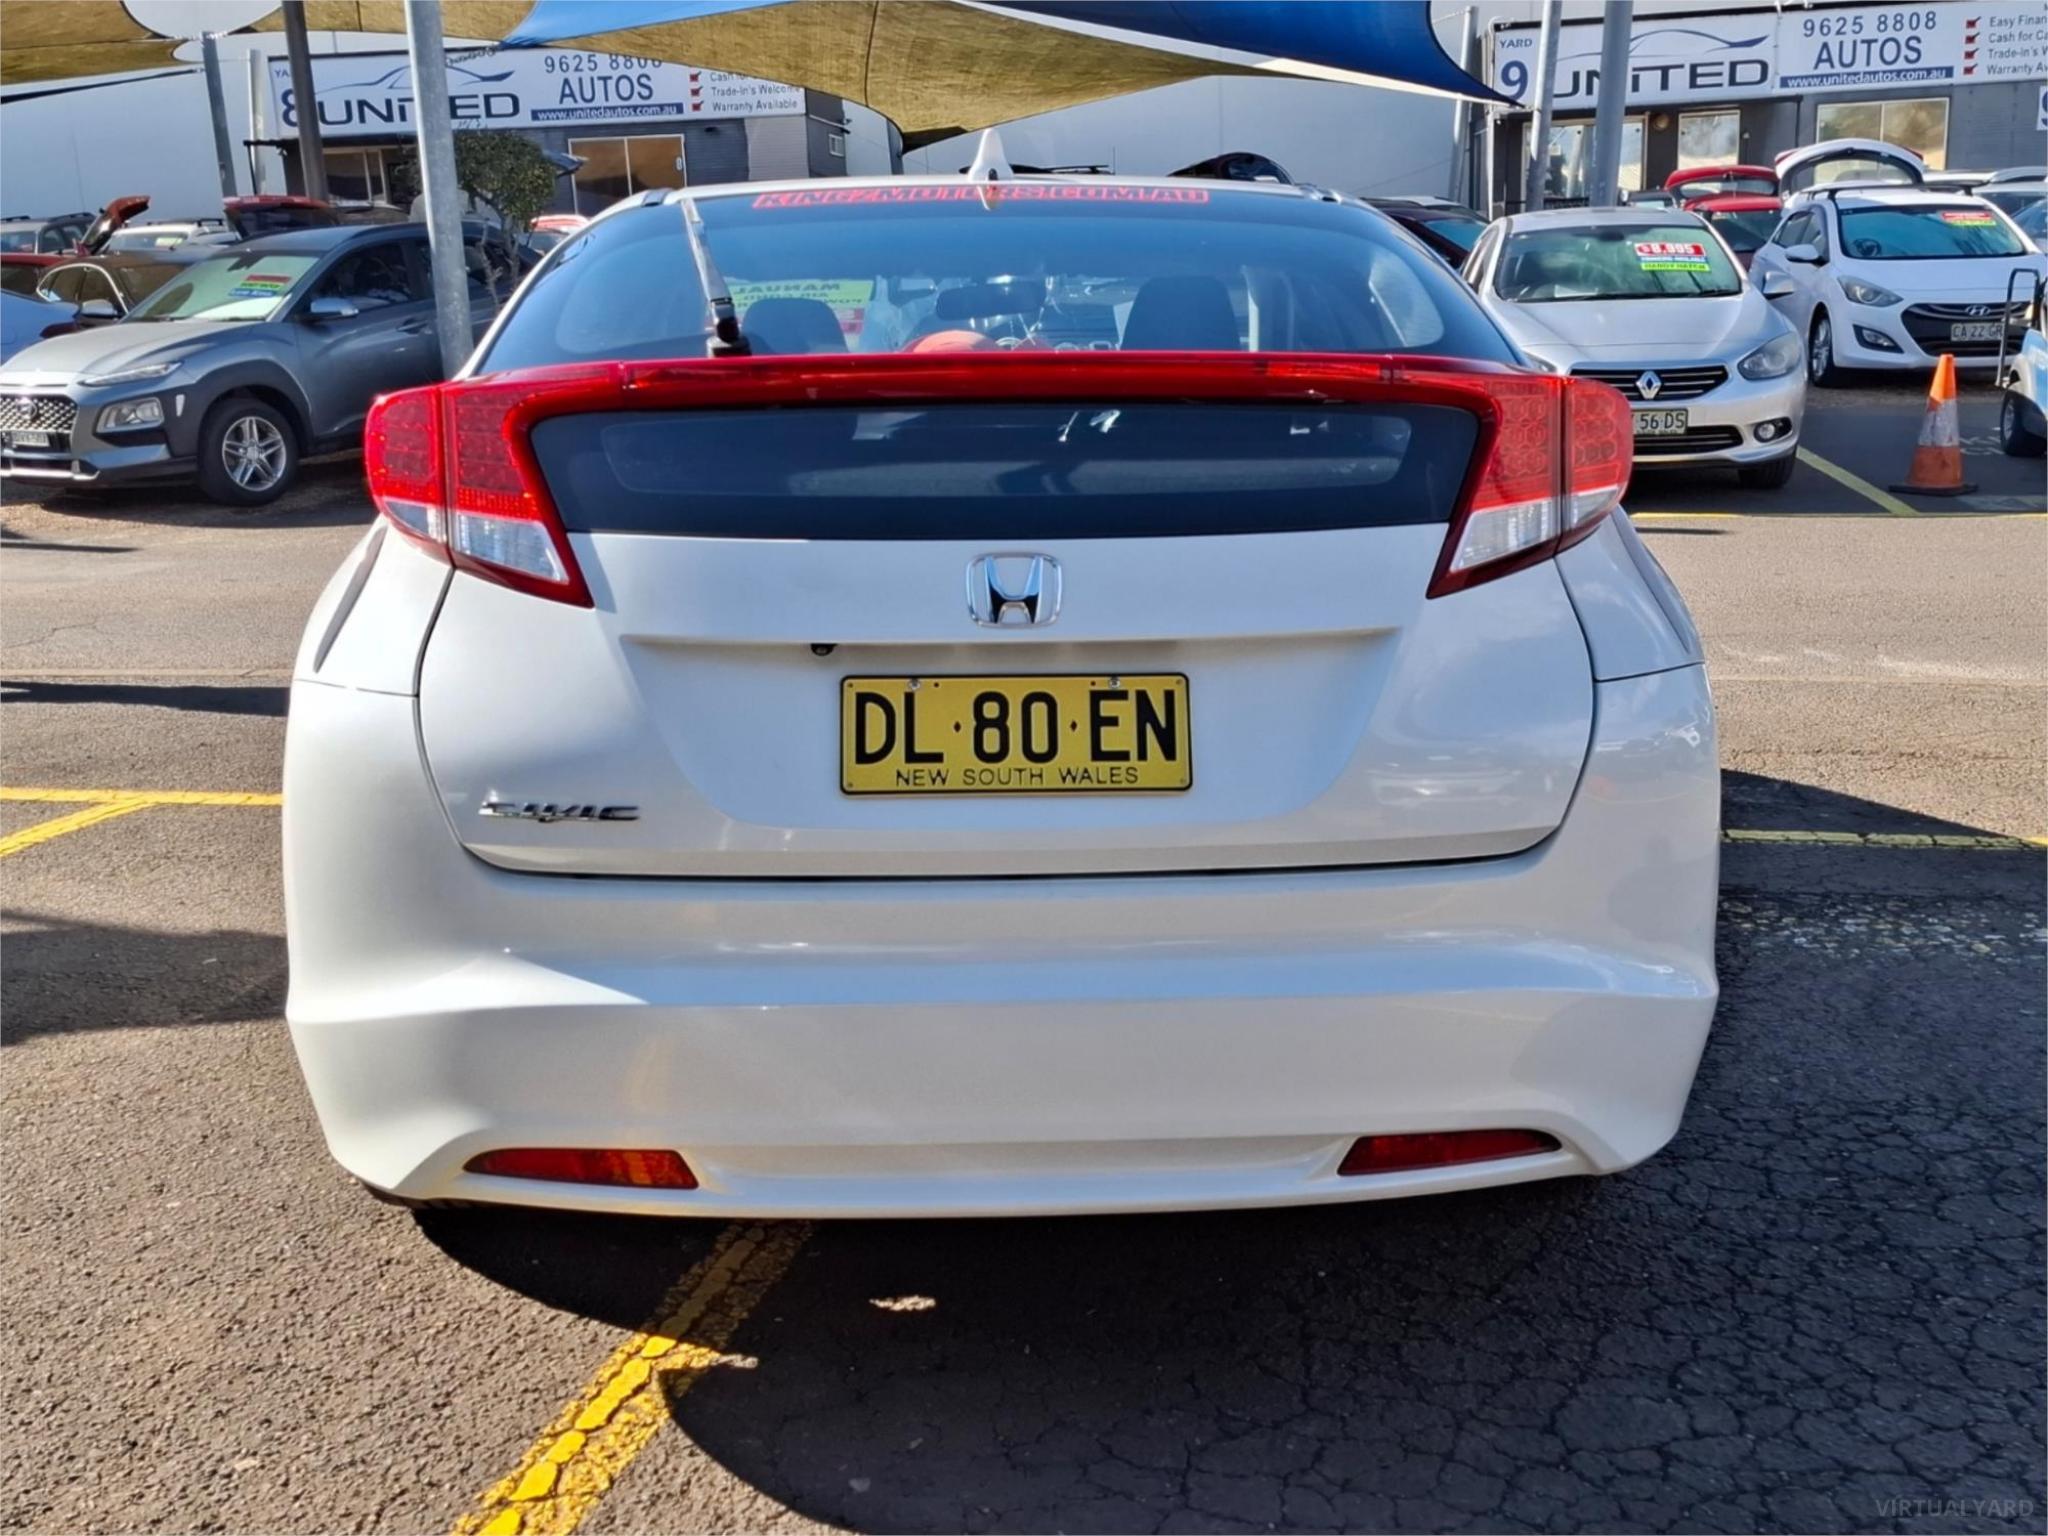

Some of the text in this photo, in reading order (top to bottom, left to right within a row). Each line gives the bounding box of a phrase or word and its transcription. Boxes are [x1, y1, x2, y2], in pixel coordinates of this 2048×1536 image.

[1803, 11, 1938, 37] 9625 8808
[1989, 16, 2014, 29] Easy
[1500, 37, 1532, 48] YARD
[1988, 32, 2015, 43] Cash
[2019, 30, 2033, 42] for
[1813, 35, 1922, 70] AUTOS
[544, 54, 598, 73] 9625
[1987, 63, 2033, 75] Warranty
[1501, 60, 1528, 100] 9
[1787, 68, 1947, 88] www.unitedautos.com.au
[559, 73, 653, 104] AUTOS
[318, 92, 520, 126] UNIED
[537, 104, 677, 121] www.unitedautos.com.au
[712, 99, 798, 113] Warranty Available
[1640, 412, 1685, 430] 56 DS
[855, 689, 1177, 764] DL 80 EN
[896, 767, 1138, 786] NEW SOUTH WALES
